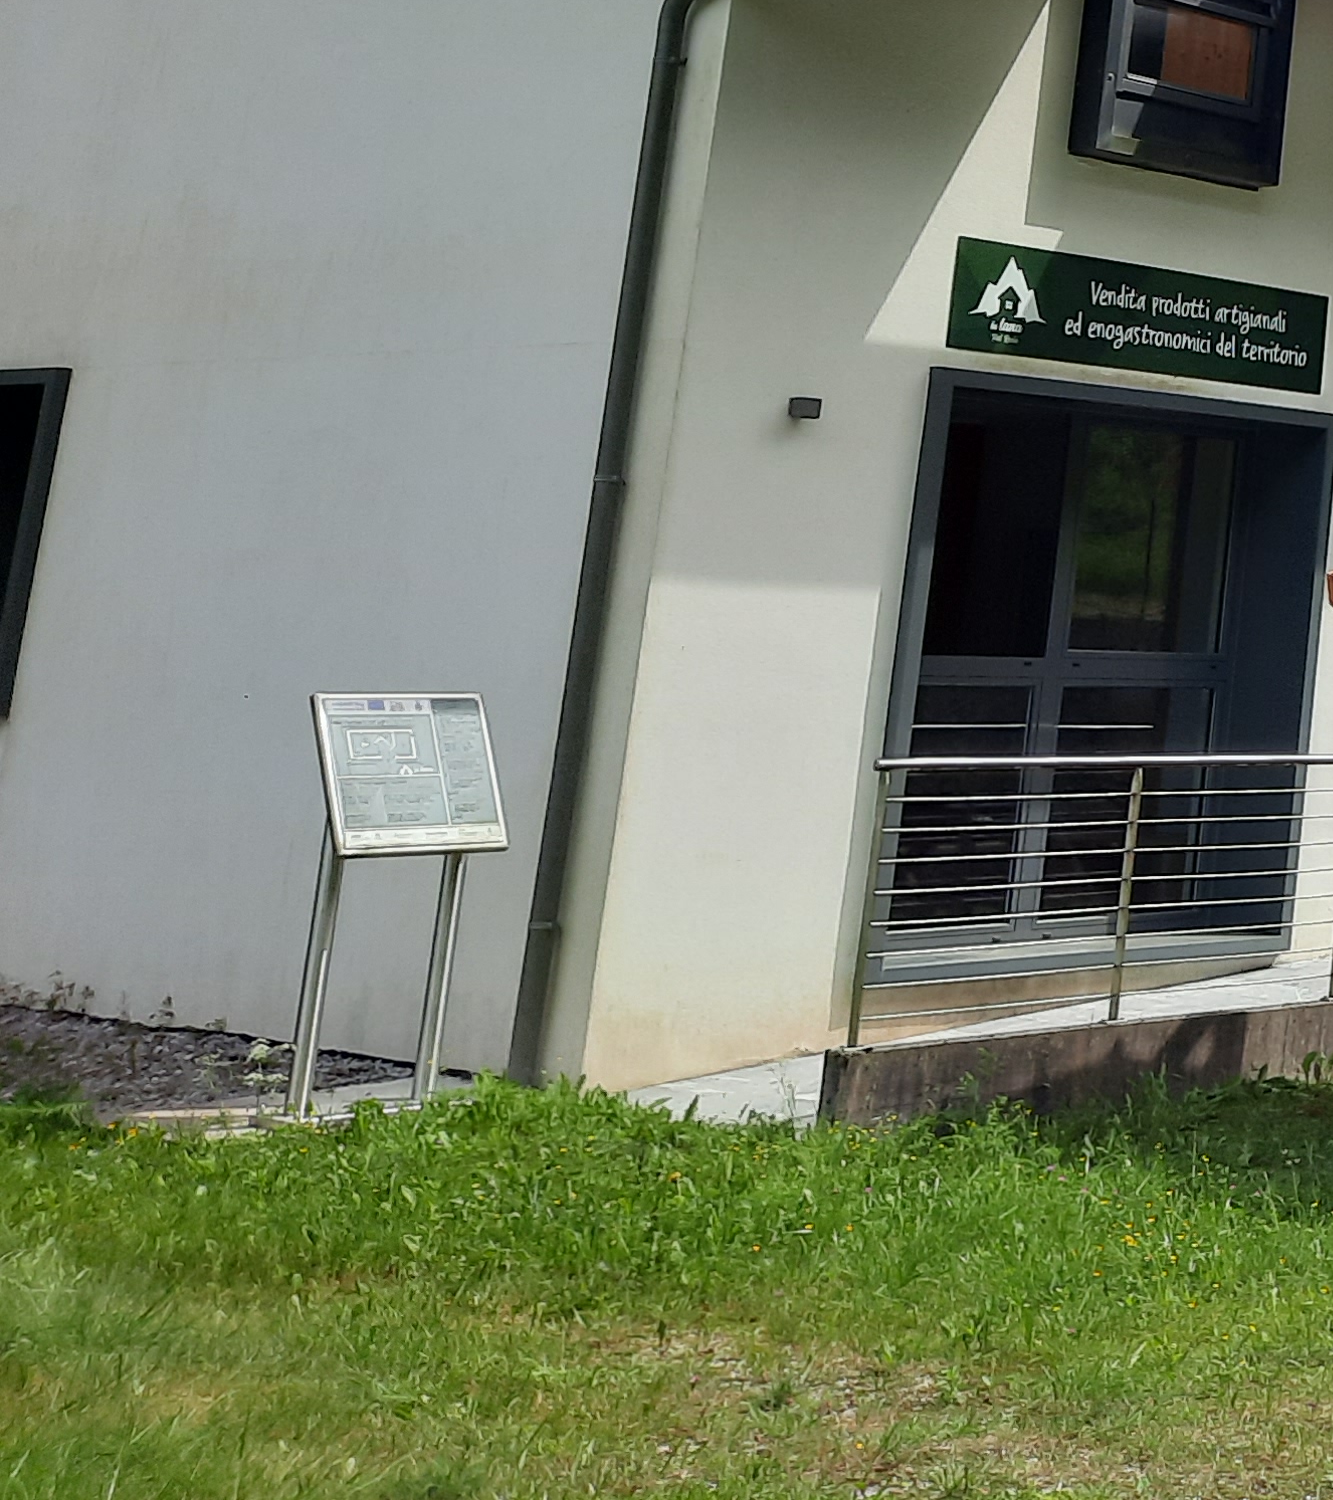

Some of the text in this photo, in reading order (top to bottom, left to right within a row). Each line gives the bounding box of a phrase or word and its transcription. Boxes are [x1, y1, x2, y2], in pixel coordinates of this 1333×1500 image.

[1090, 280, 1287, 335] Vendita prodotti artigianali
[1064, 311, 1307, 367] ed enogastronomici del territorio
